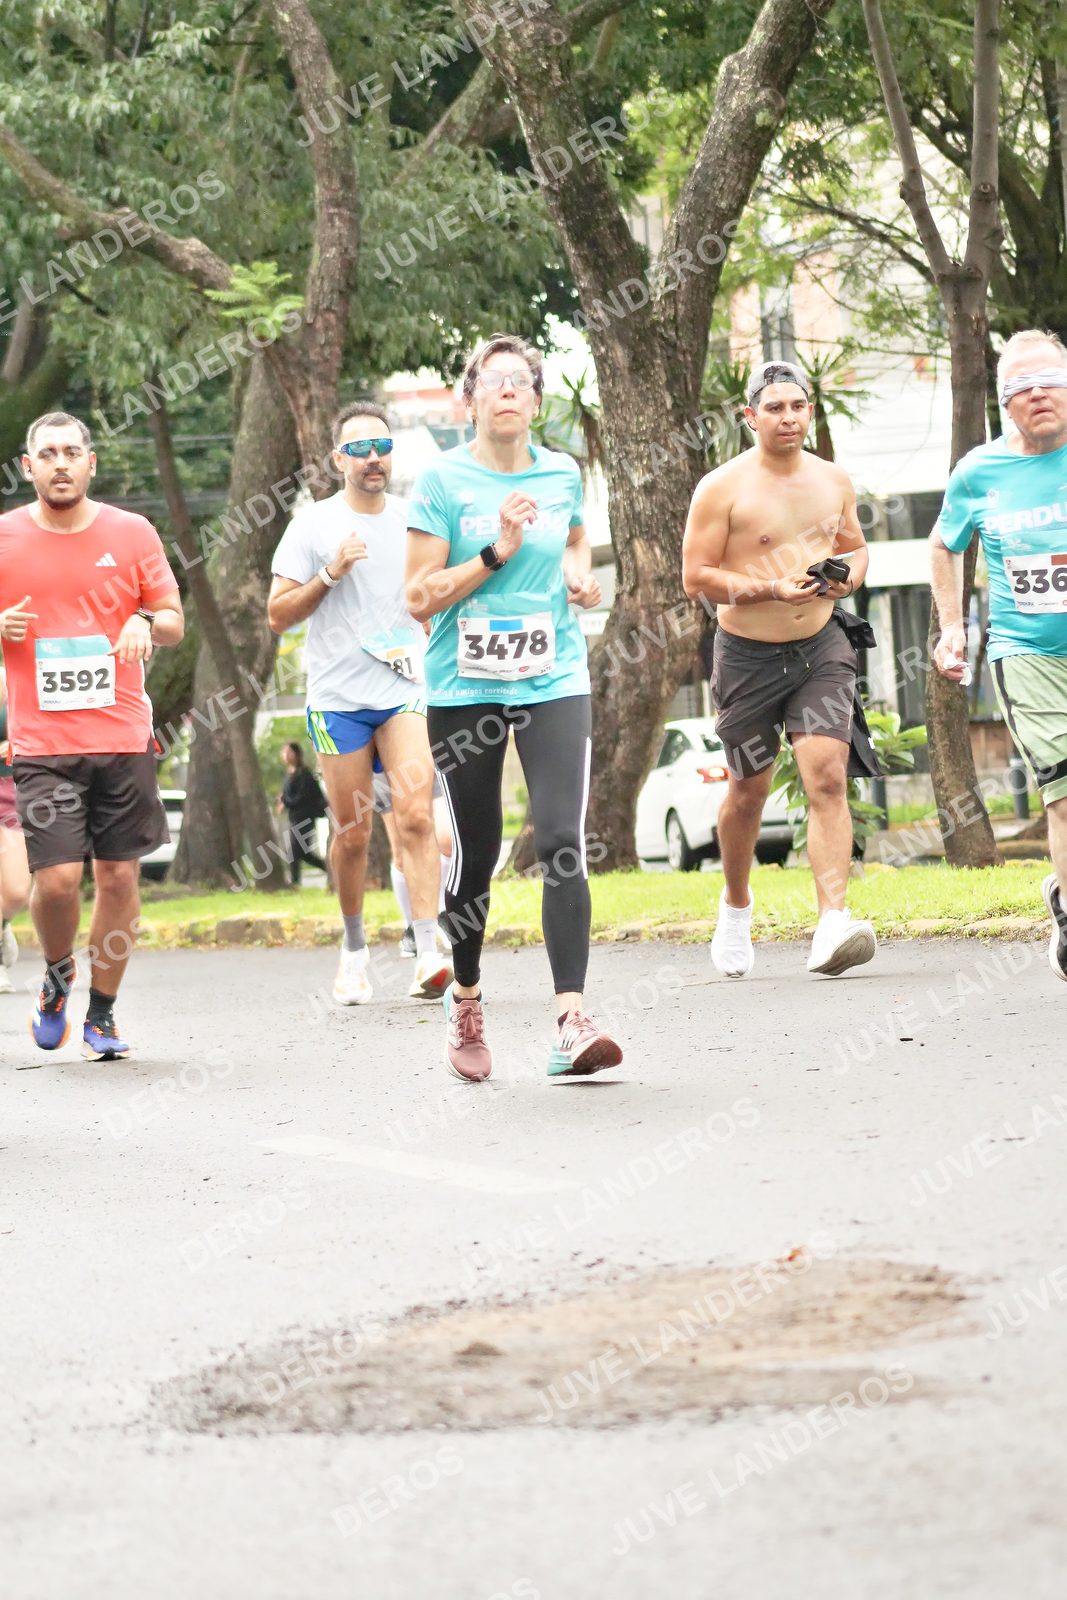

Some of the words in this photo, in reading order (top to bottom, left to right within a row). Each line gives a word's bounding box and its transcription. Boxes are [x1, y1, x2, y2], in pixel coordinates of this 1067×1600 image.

[1012, 567, 1067, 594] 336
[464, 629, 548, 660] 3478
[384, 657, 412, 675] 81
[42, 668, 110, 693] 3592
